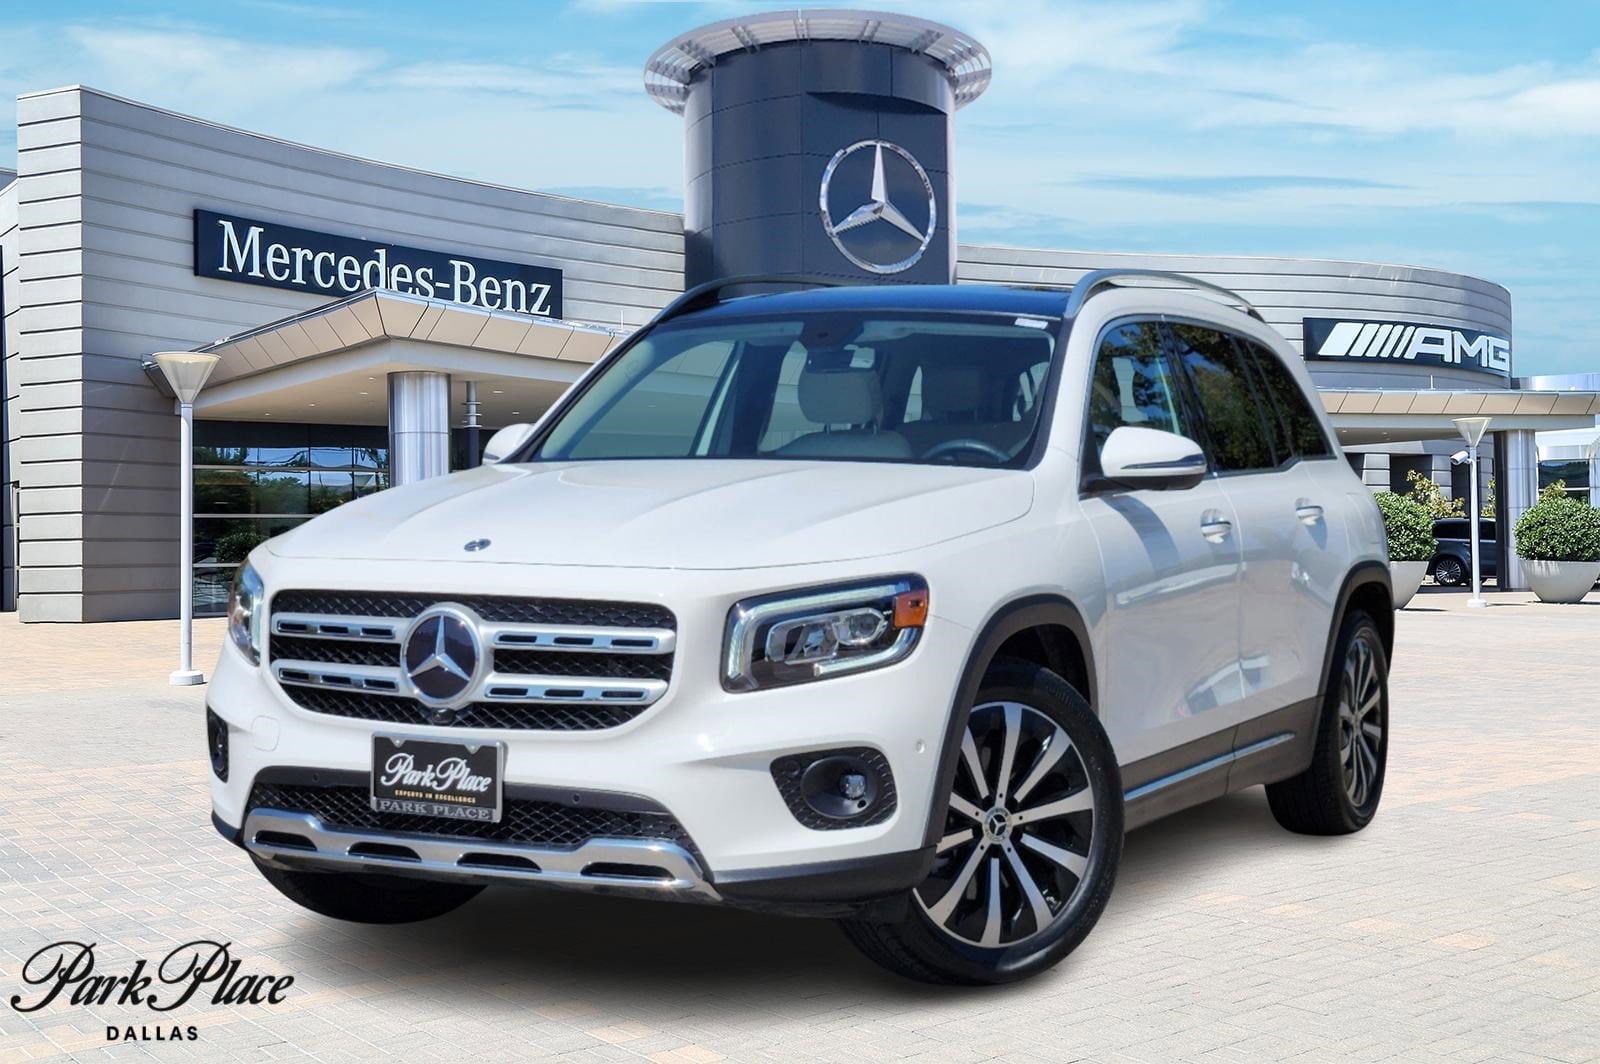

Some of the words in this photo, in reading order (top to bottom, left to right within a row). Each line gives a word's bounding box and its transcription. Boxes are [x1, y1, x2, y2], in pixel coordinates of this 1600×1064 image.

[217, 219, 552, 316] Mercedes-Benz
[1403, 326, 1510, 372] AMG
[380, 752, 436, 788] Park
[431, 757, 492, 792] Place
[380, 800, 427, 813] PARK
[433, 805, 490, 819] PLACE
